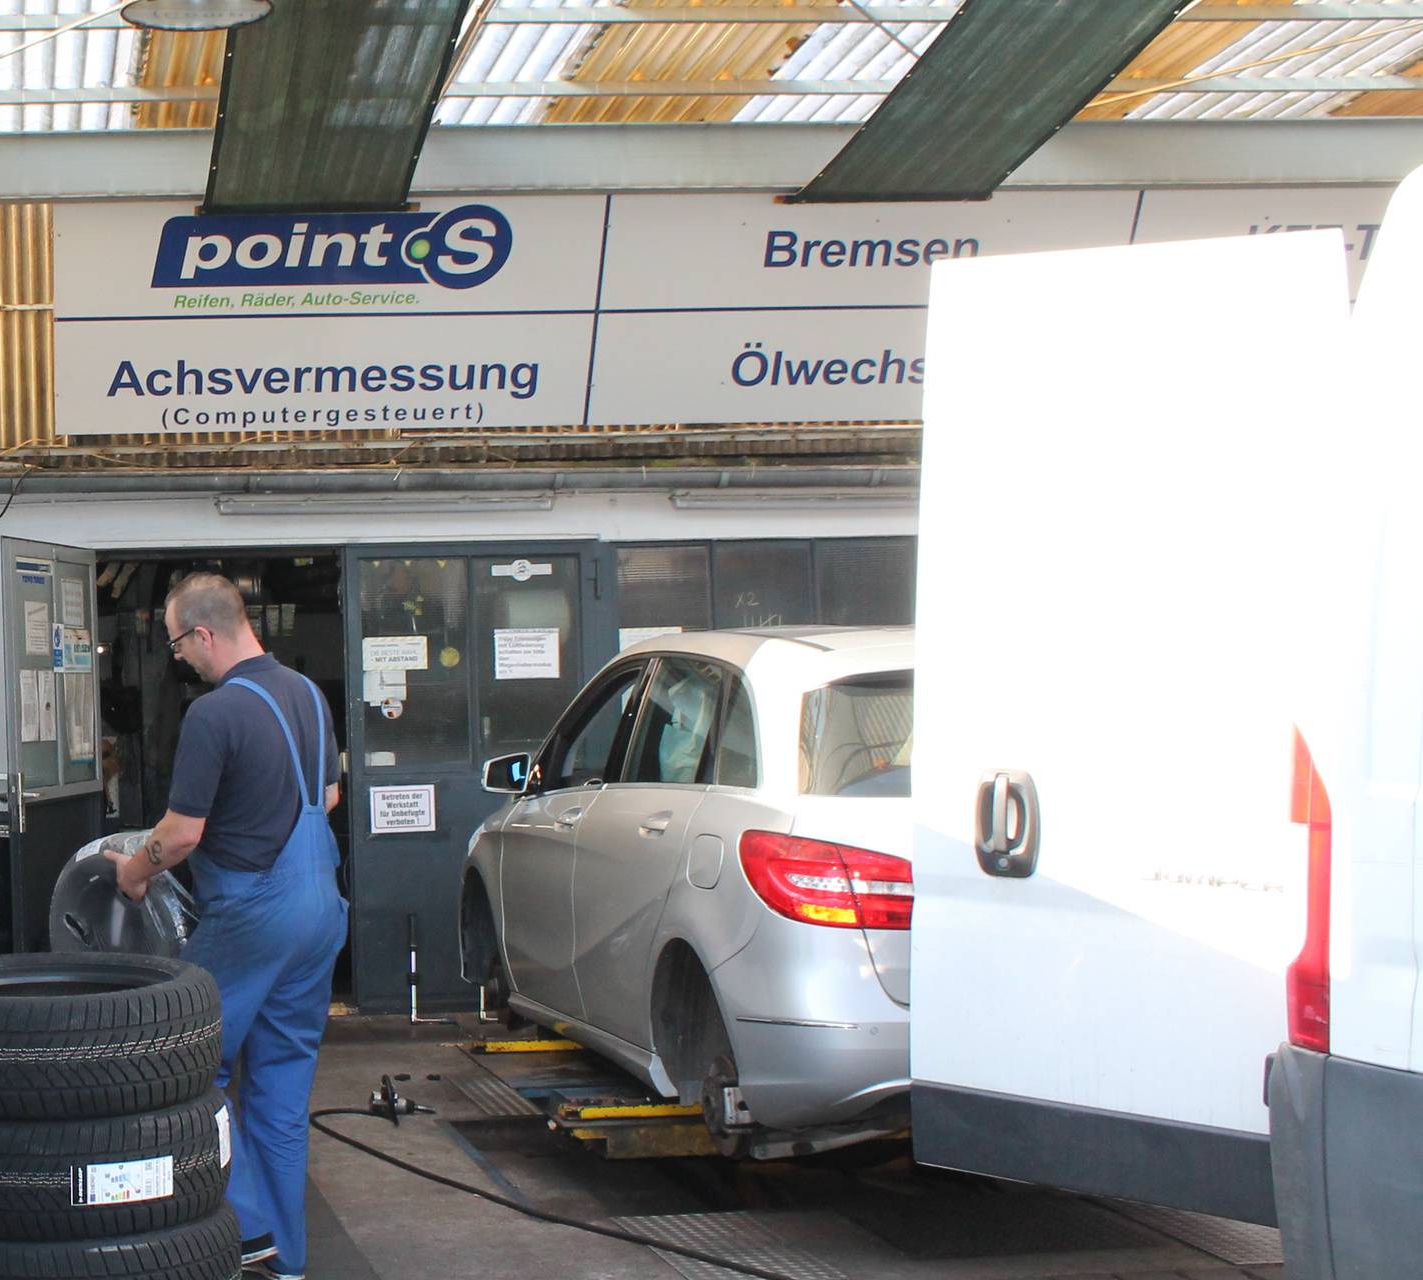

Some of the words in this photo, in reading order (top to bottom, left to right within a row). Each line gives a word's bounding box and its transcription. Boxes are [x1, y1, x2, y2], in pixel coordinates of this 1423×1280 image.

[180, 223, 392, 279] point
[438, 218, 496, 275] S
[763, 230, 979, 268] Bremsen
[174, 294, 236, 310] Reifen,
[240, 291, 297, 309] Räder,
[301, 290, 420, 306] Auto-Service.
[106, 360, 540, 400] Achsvermessung
[161, 403, 484, 429] (Computergesteuert)
